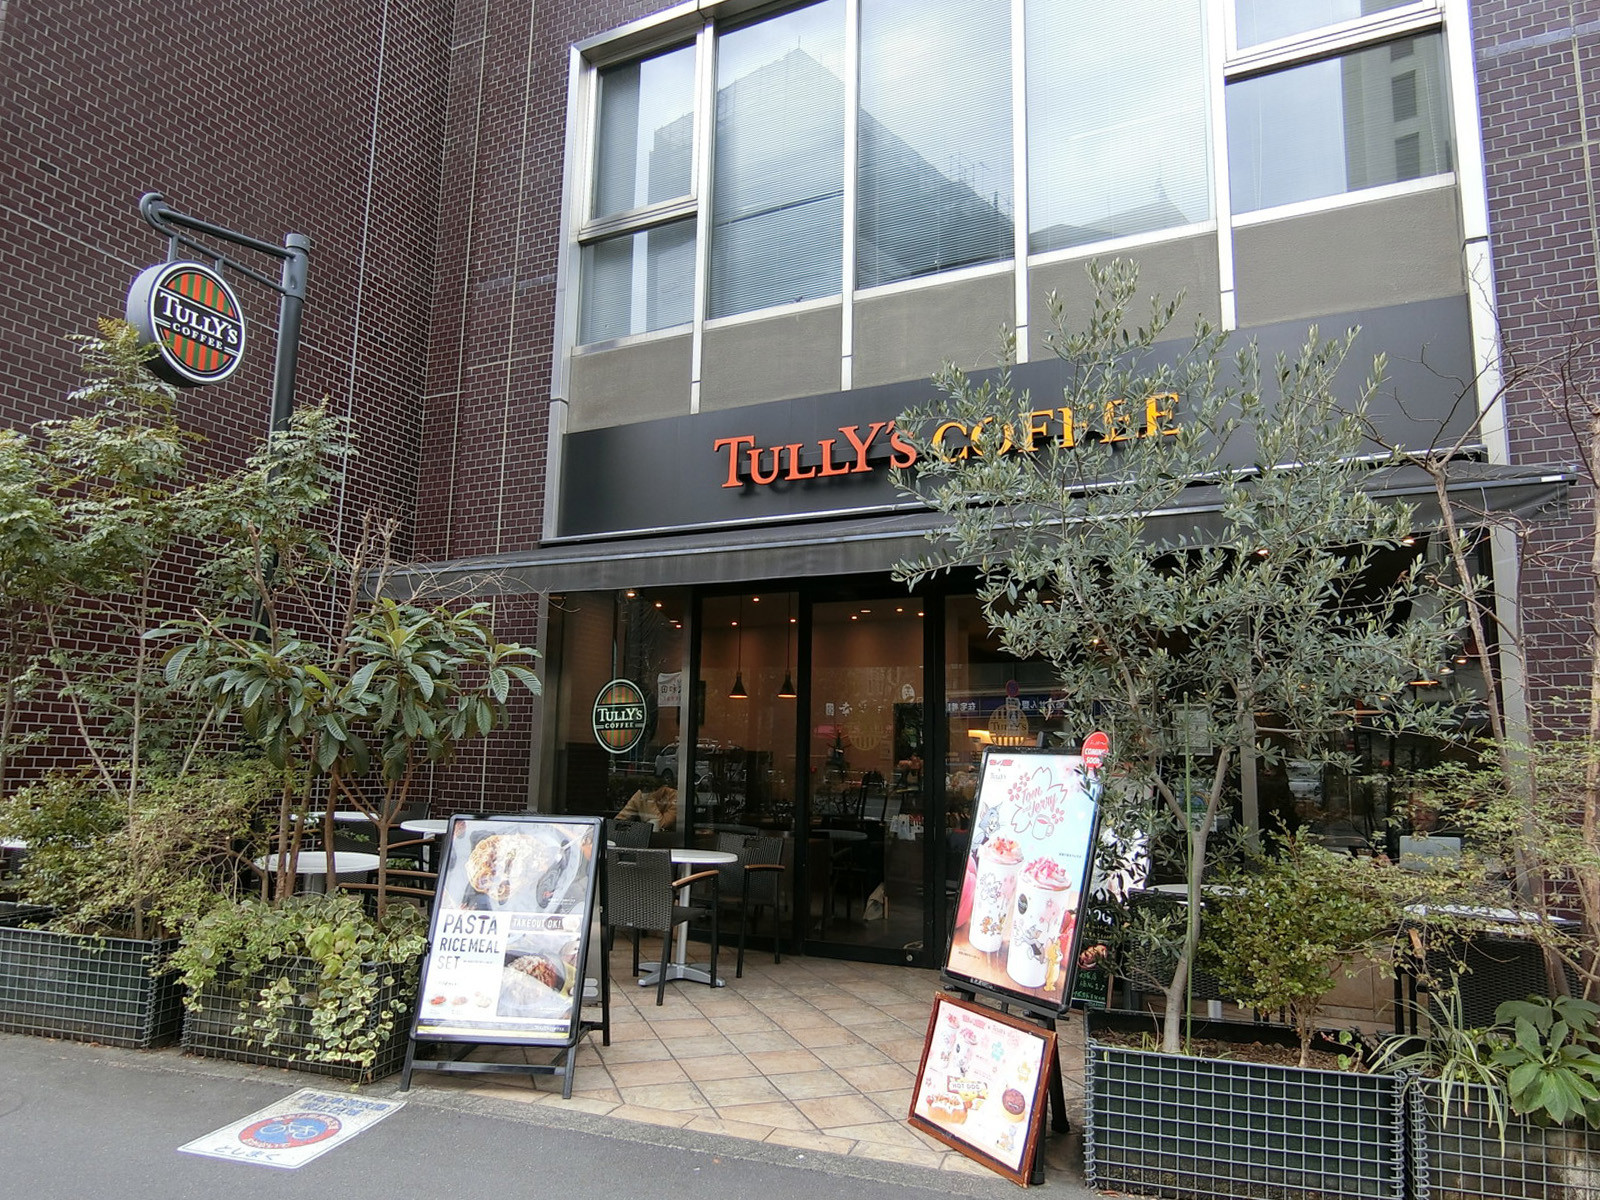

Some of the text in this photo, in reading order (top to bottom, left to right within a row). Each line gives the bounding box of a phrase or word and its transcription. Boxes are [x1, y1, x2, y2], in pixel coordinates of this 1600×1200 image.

[160, 291, 239, 345] TULLY'S
[172, 322, 225, 350] COFFEE
[713, 419, 917, 489] TULLY'S
[597, 707, 643, 722] TULLY'S
[1022, 786, 1043, 805] Tom
[1028, 793, 1058, 818] Jerry
[443, 914, 497, 935] PASTA
[513, 918, 561, 929] TAKEOUT OK!
[439, 937, 500, 954] RICE MEAL
[437, 955, 461, 970] SET
